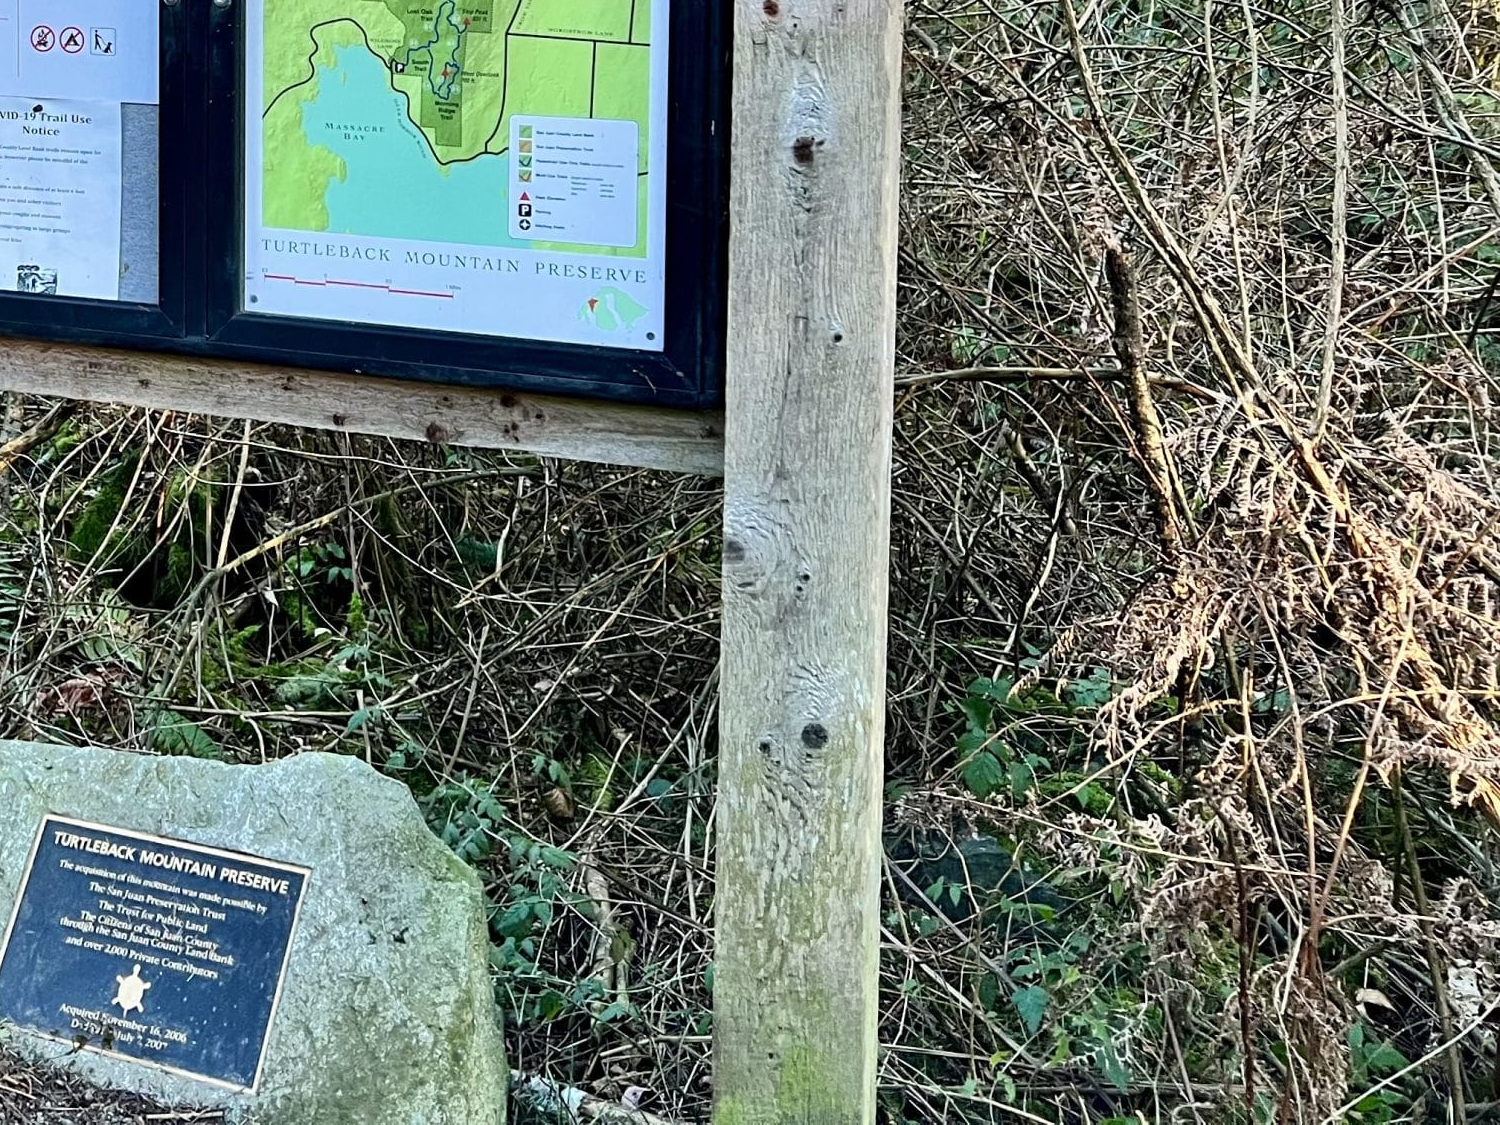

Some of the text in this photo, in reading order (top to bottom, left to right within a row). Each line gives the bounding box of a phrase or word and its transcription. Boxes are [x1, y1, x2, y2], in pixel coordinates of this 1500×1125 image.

[22, 125, 59, 136] Notice
[39, 112, 67, 122] Trail
[71, 114, 91, 124] Use
[262, 239, 646, 284] TURTLEBACK MOUNTAIN PRESERVE
[54, 831, 290, 895] TURTLEBACK MOUNTAIN PRESERVE
[60, 859, 268, 915] The acquisition of this mountain was made possible by
[90, 881, 226, 921] The San Juan Preservation Trust
[80, 911, 218, 951] The Citizens of San Juan County
[100, 899, 208, 933] The Trust for Public Land
[60, 917, 94, 933] through
[96, 925, 110, 935] the
[112, 929, 128, 939] San
[128, 933, 150, 945] Juan
[150, 939, 182, 955] County
[186, 945, 208, 959] Land
[66, 937, 84, 945] and
[84, 941, 104, 951] over
[128, 949, 160, 965] Private
[162, 957, 218, 979] Contributors
[60, 1003, 100, 1021] Acquired
[164, 1029, 186, 1043] 2006
